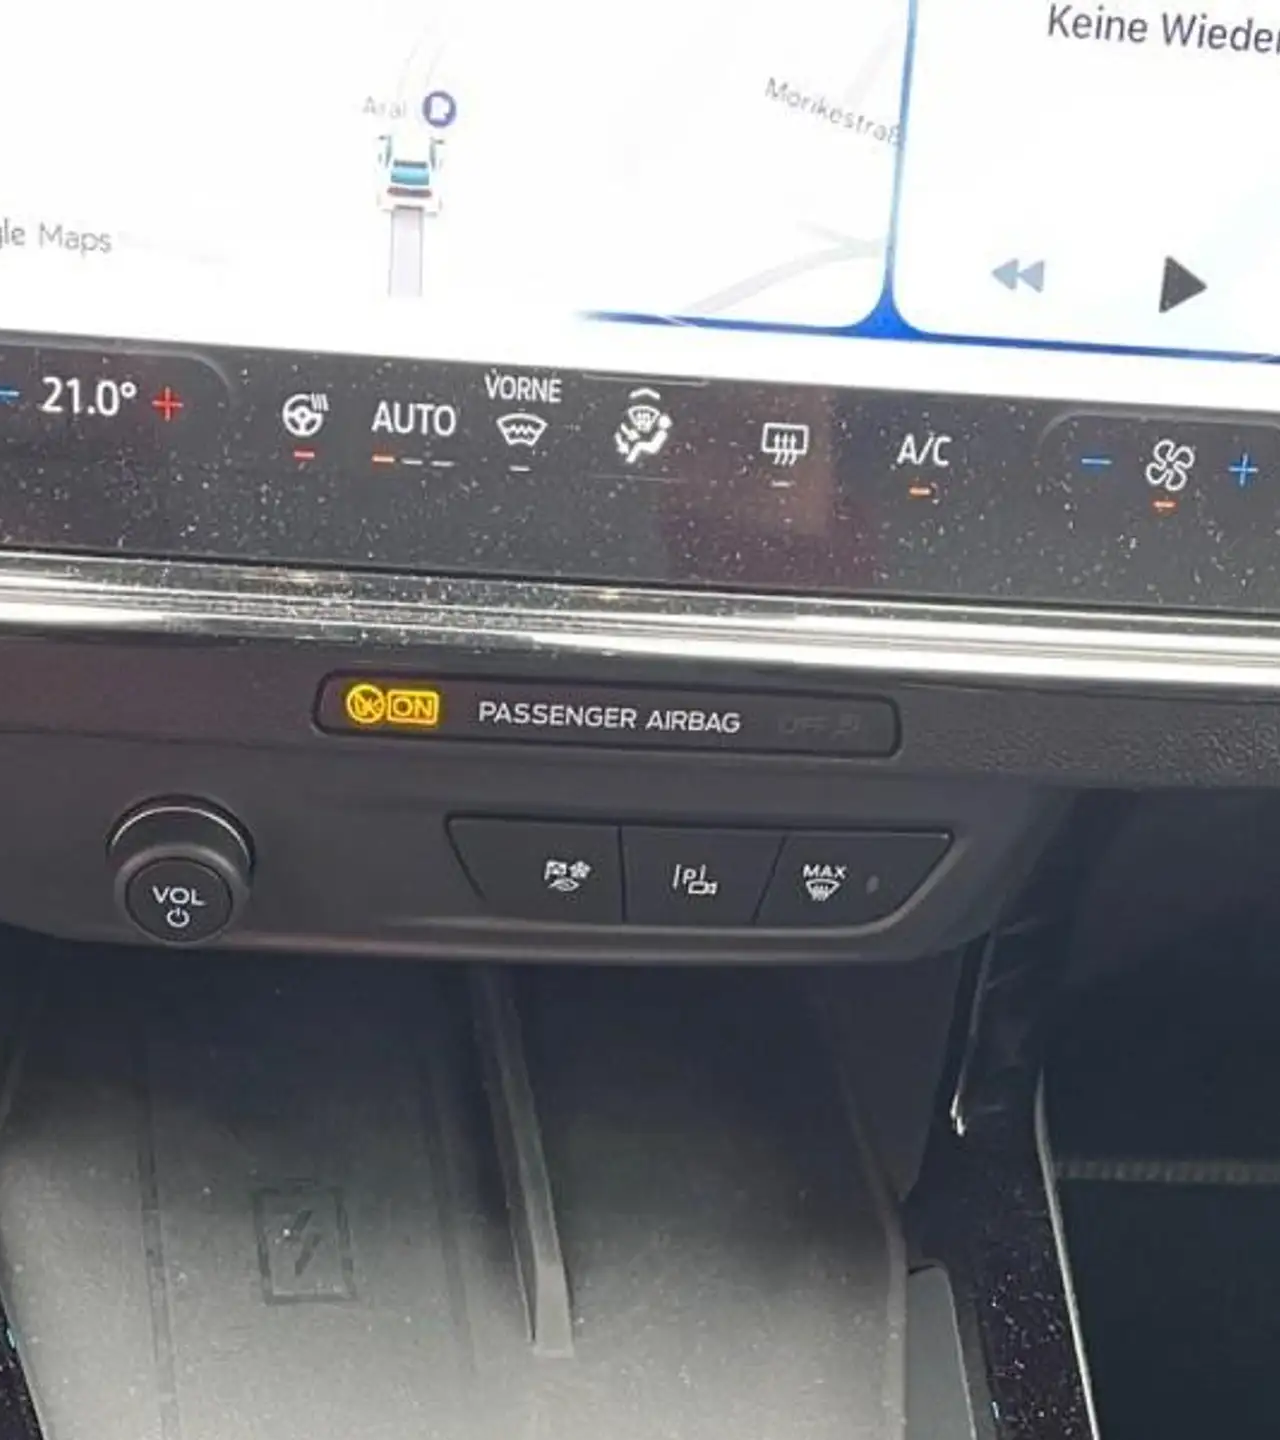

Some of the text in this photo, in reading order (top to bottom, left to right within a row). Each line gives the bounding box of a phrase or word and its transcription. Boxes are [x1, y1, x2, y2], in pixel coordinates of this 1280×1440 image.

[1047, 3, 1148, 43] Keine
[38, 221, 113, 259] Maps
[41, 376, 137, 416] 21.0°
[484, 373, 563, 404] VORNE
[371, 400, 457, 437] AUTO
[896, 433, 952, 467] A/C
[390, 696, 433, 718] ON
[478, 700, 742, 734] PASSENGER AIRBAG
[802, 864, 847, 880] MAX
[152, 885, 208, 907] VOL
